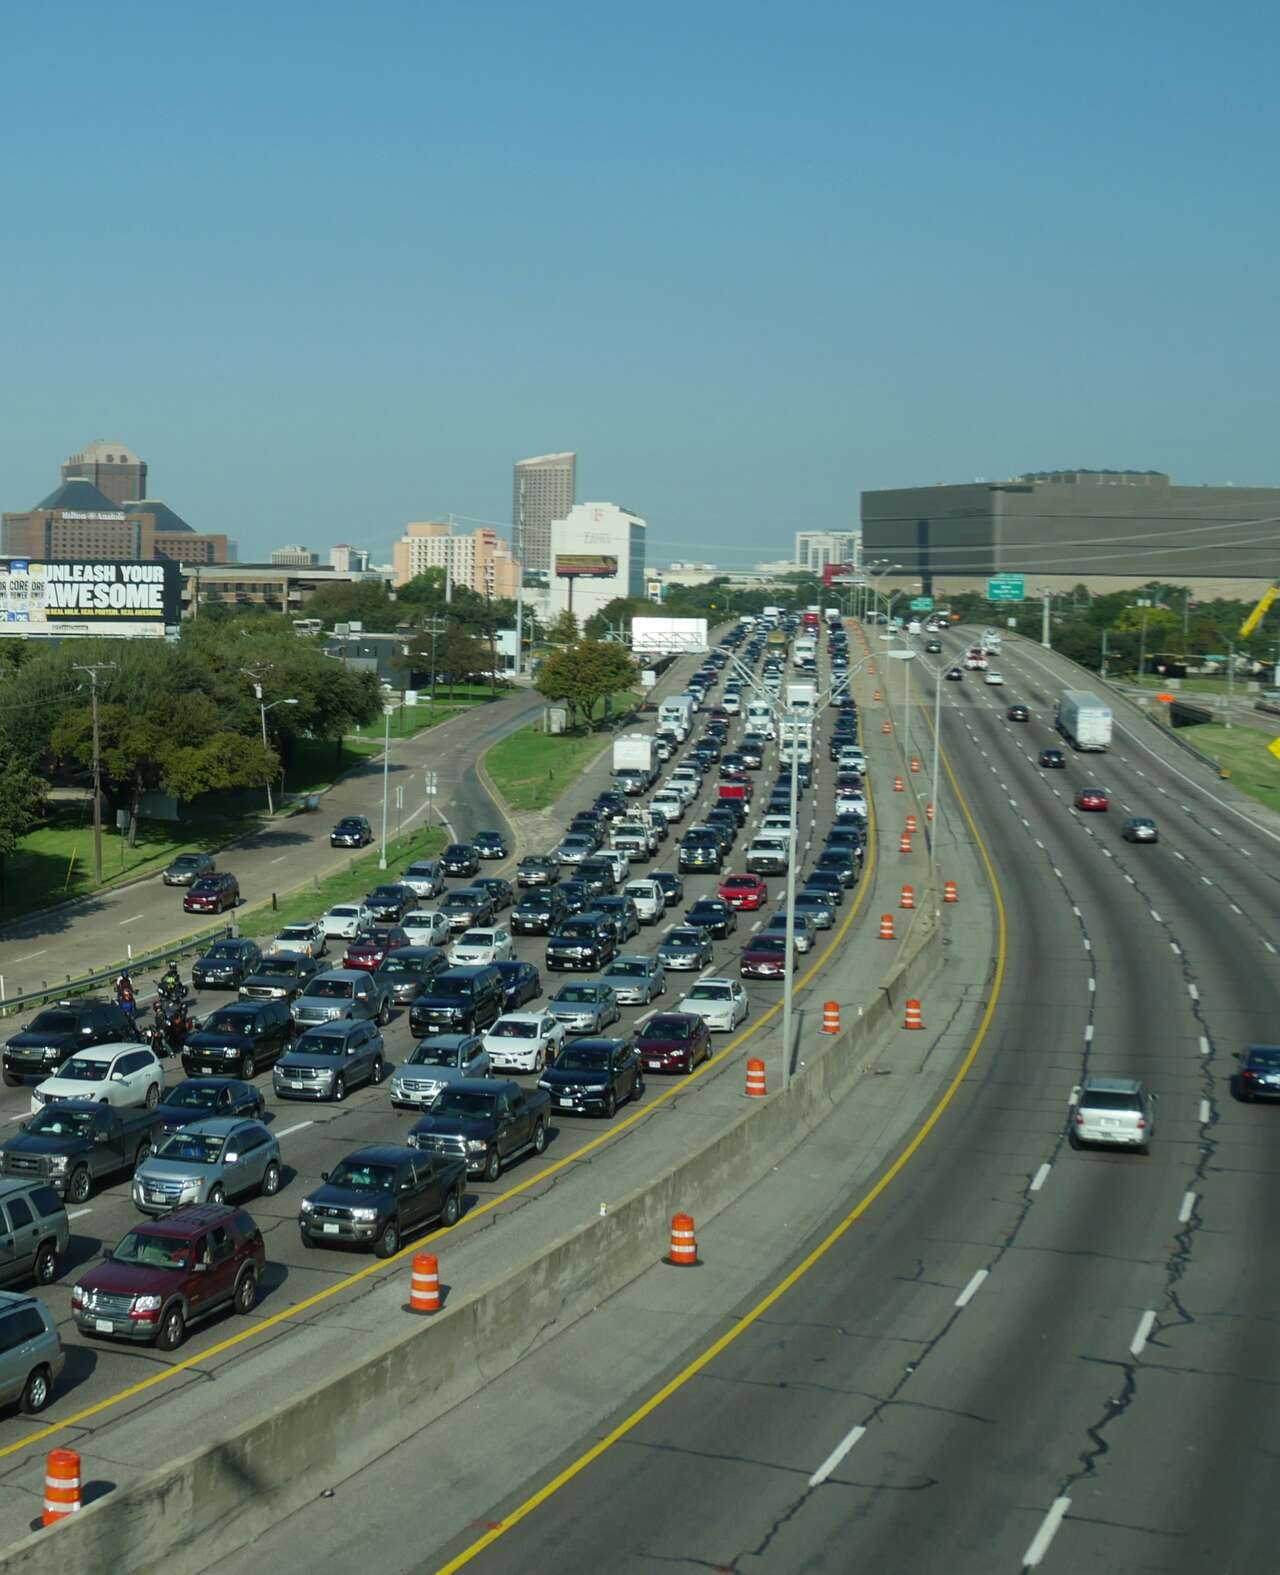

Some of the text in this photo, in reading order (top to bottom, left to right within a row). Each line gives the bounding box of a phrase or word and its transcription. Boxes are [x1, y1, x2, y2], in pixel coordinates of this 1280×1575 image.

[46, 564, 165, 583] UNLEASH YOUR
[9, 581, 29, 591] CORE
[31, 582, 45, 591] ORE
[45, 583, 164, 609] AWESOME
